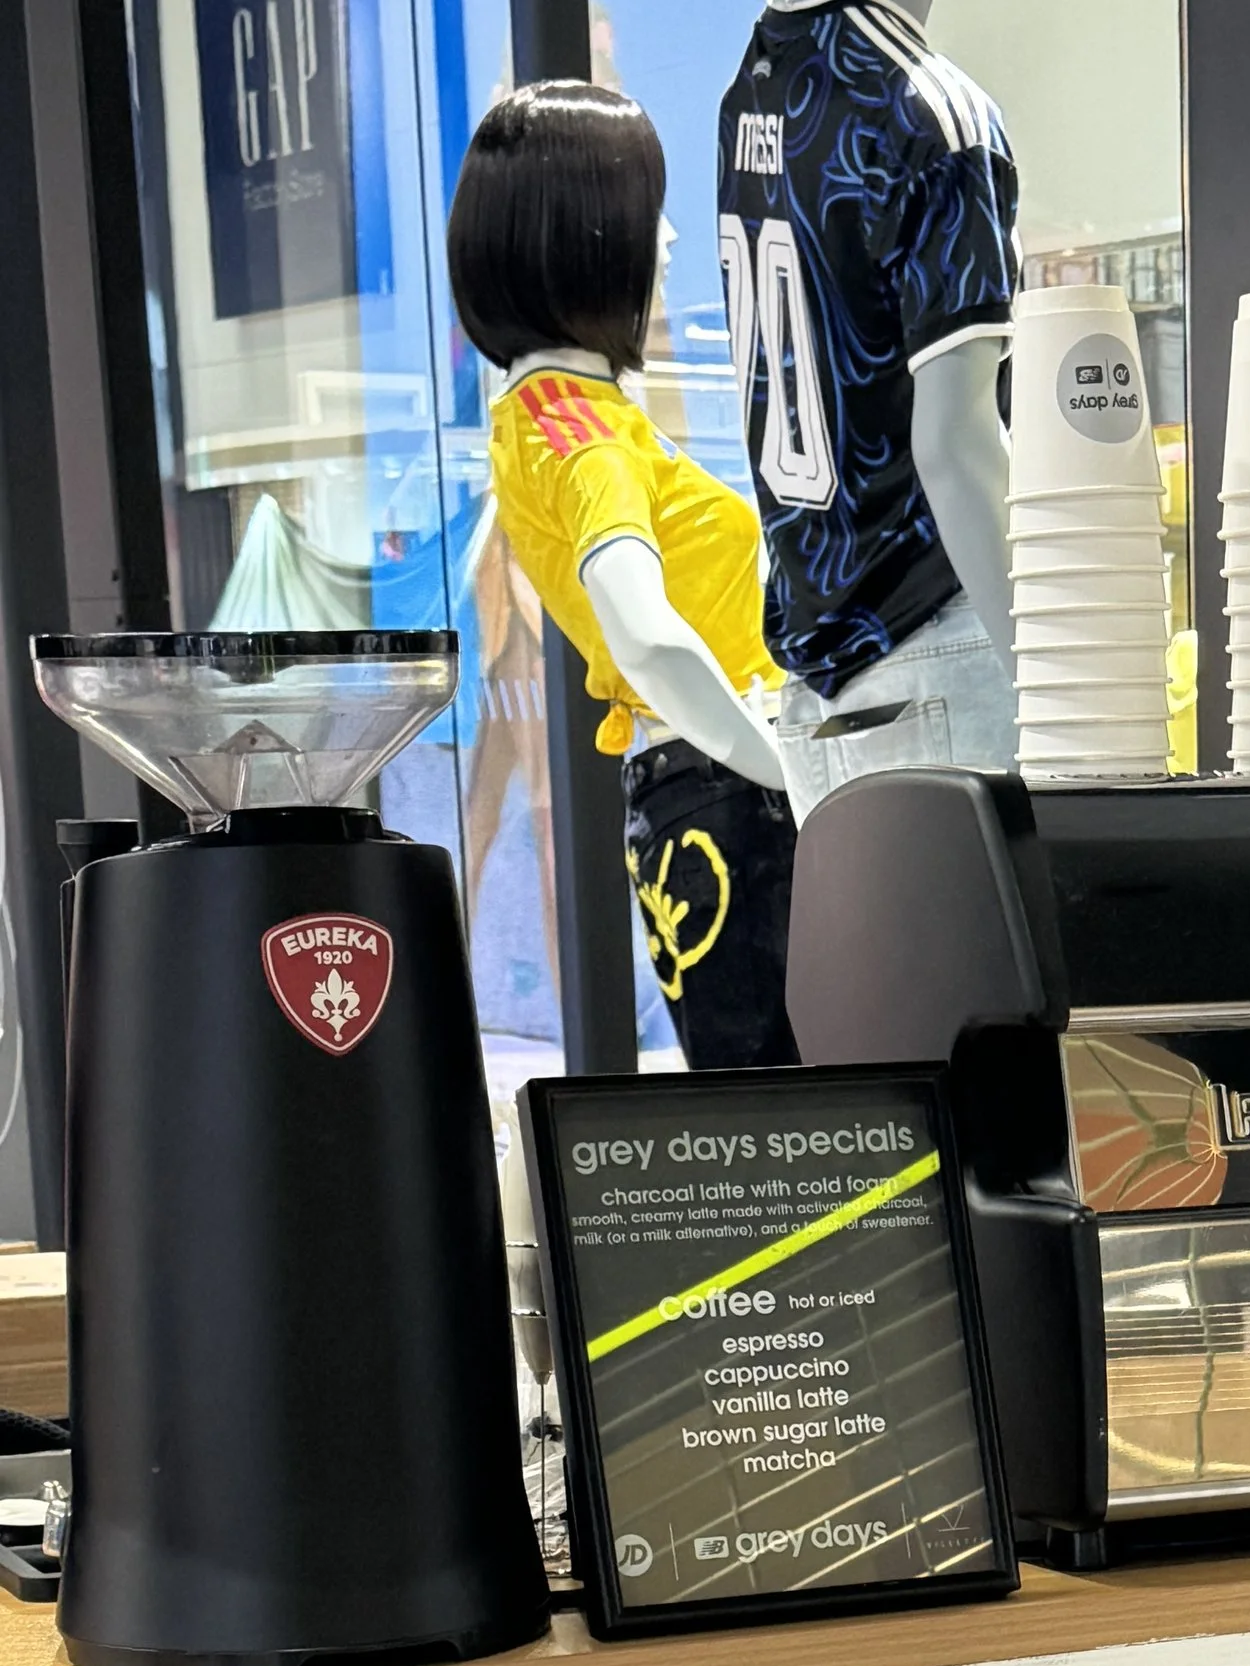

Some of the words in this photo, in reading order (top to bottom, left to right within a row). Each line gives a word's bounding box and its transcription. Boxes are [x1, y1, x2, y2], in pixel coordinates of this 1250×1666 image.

[233, 0, 318, 167] GAP
[734, 110, 785, 175] MESSI
[1069, 394, 1108, 411] days
[1112, 393, 1138, 409] grey
[281, 927, 377, 956] EUREKA
[314, 951, 353, 965] 1920
[572, 1138, 655, 1175] grey
[667, 1131, 757, 1166] days
[766, 1121, 915, 1163] specials
[601, 1184, 694, 1206] charcoal
[699, 1182, 745, 1202] latte
[750, 1178, 791, 1198] with
[797, 1175, 841, 1196] cold
[847, 1174, 898, 1194] foam
[571, 1211, 628, 1228] smooth,
[631, 1210, 684, 1227] creamy
[687, 1206, 719, 1221] latte
[722, 1205, 762, 1220] made
[766, 1202, 794, 1217] with
[796, 1197, 861, 1215] activated
[864, 1195, 928, 1211] charcoal,
[574, 1231, 602, 1246] milk
[607, 1231, 626, 1246] (or
[630, 1232, 640, 1243] a
[643, 1228, 672, 1242] milk
[675, 1222, 758, 1241] alternative),
[760, 1221, 788, 1236] and
[791, 1223, 801, 1234] a
[804, 1218, 843, 1233] touch
[846, 1217, 860, 1230] of
[861, 1214, 934, 1230] sweetener.
[658, 1288, 776, 1321] coffee
[788, 1294, 815, 1309] hot
[819, 1295, 835, 1308] or
[839, 1290, 876, 1306] iced
[722, 1331, 824, 1356] espresso
[704, 1357, 850, 1387] cappuccino
[712, 1391, 791, 1416] vanilla
[798, 1386, 849, 1409] latte
[681, 1426, 757, 1448] brown
[763, 1421, 829, 1444] sugar
[834, 1413, 887, 1436] latte
[743, 1448, 837, 1474] matcha
[617, 1544, 648, 1566] JD
[735, 1529, 808, 1564] grey
[811, 1519, 888, 1549] days
